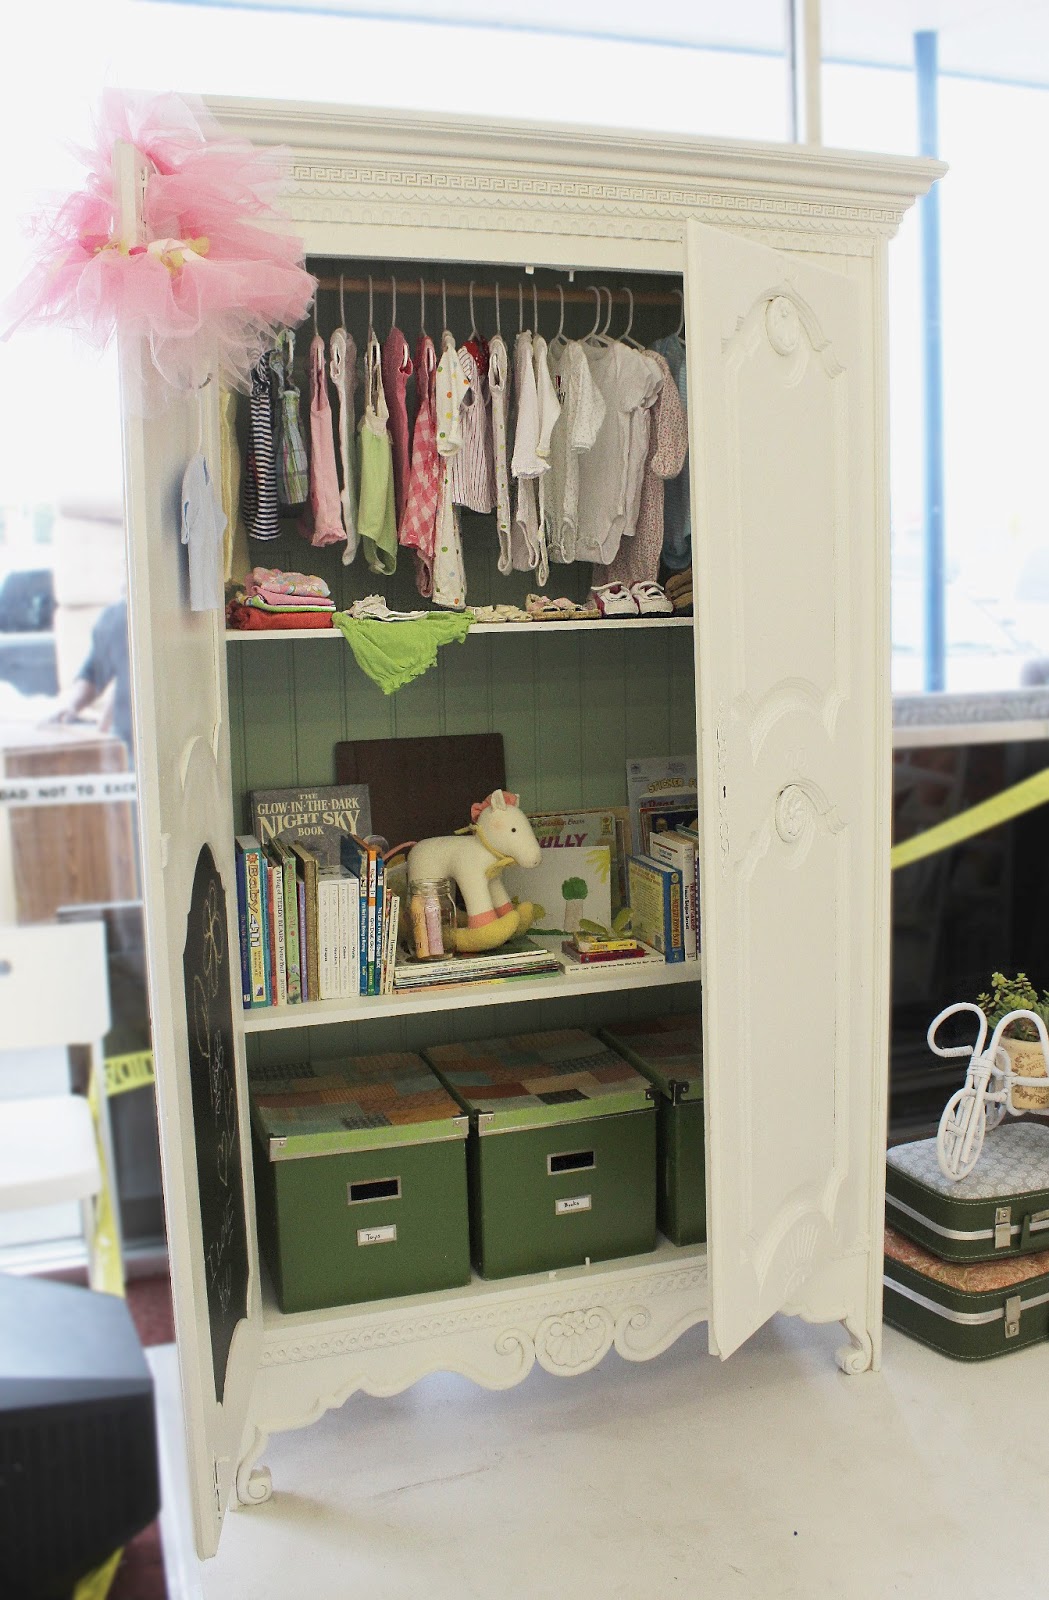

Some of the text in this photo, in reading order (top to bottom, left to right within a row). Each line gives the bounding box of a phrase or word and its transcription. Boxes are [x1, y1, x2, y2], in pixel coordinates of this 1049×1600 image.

[38, 785, 67, 799] NOT
[76, 784, 95, 796] TO
[257, 809, 361, 845] NIGHT SKY
[567, 817, 586, 827] Bears
[297, 825, 325, 837] BOOK
[247, 863, 260, 914] Baby
[250, 913, 261, 948] 411
[563, 1201, 581, 1209] Books
[365, 1232, 382, 1242] Toys
